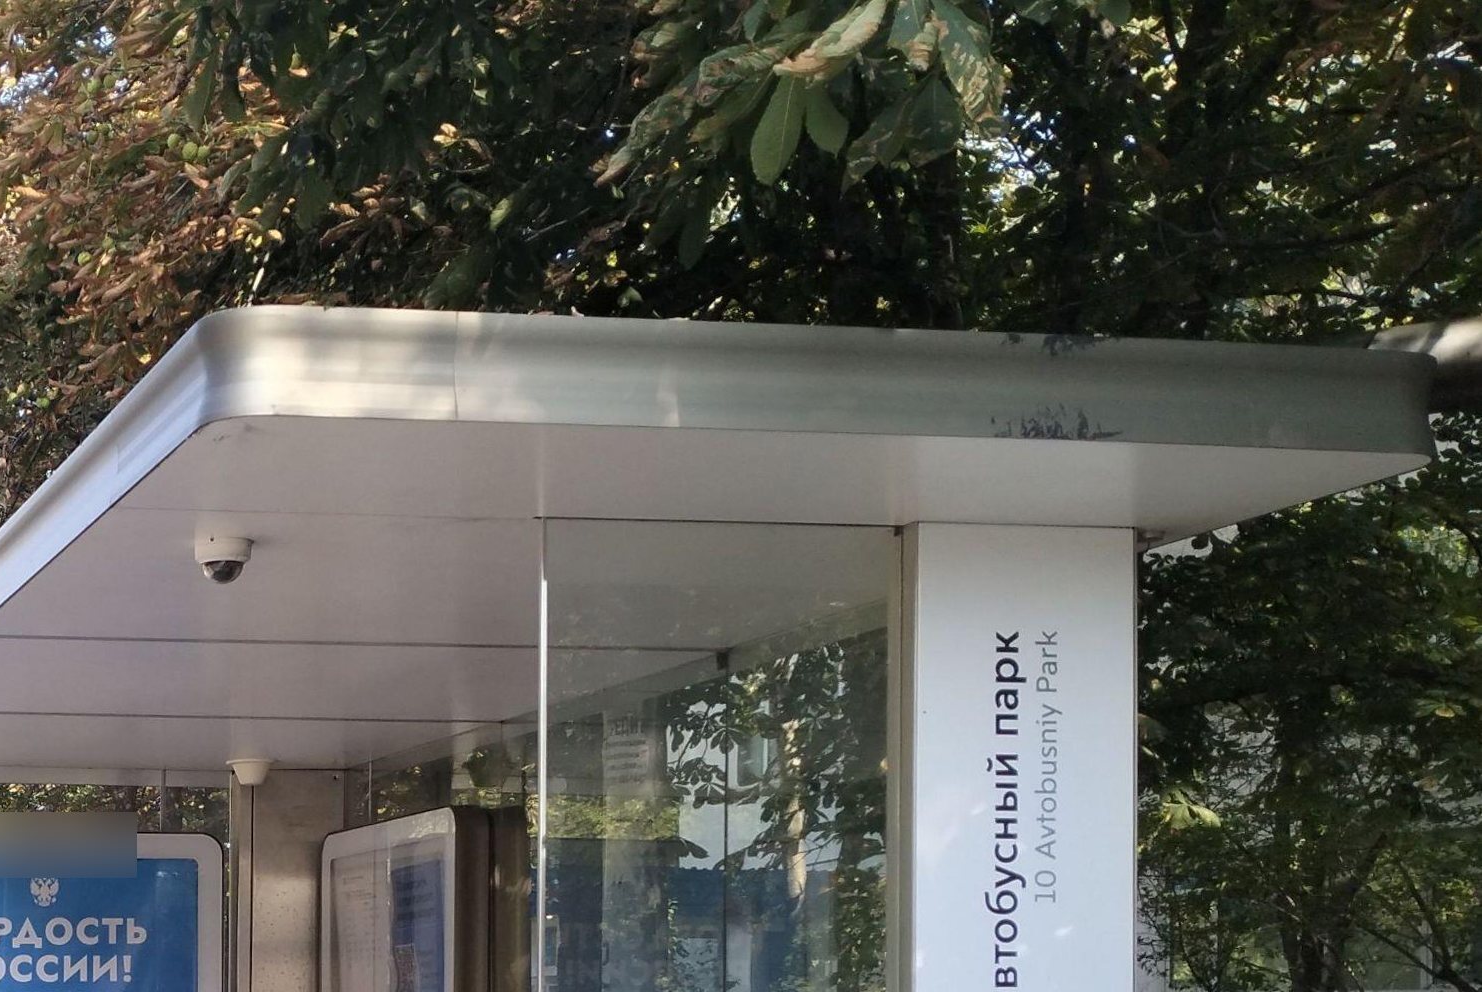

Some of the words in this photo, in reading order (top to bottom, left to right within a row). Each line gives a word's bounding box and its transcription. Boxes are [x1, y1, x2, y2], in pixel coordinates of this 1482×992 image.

[995, 631, 1027, 735] парк
[1035, 631, 1058, 693] Park
[1034, 703, 1063, 860] Avtobusniy
[1034, 870, 1057, 903] 10
